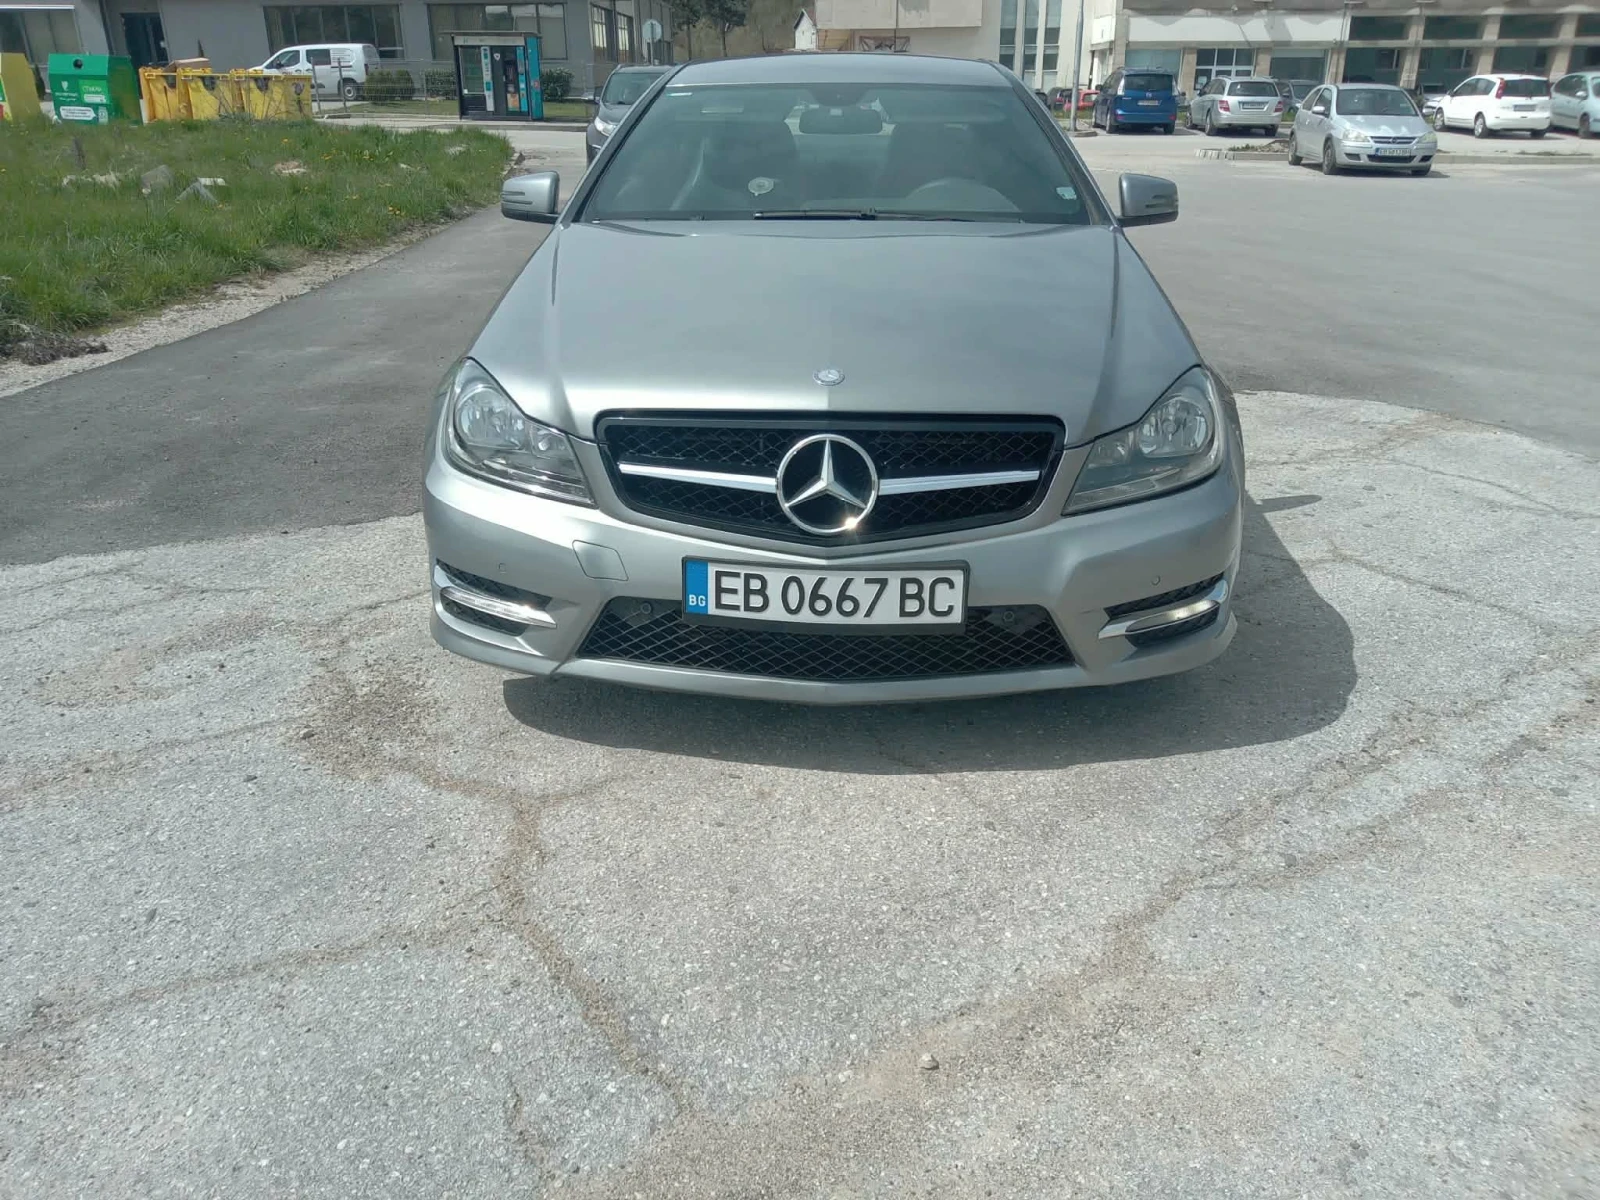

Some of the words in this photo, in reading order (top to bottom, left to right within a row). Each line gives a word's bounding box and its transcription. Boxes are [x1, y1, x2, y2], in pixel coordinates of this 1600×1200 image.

[688, 594, 706, 607] BG
[715, 570, 770, 612] EB
[781, 575, 889, 618] 0667
[899, 577, 955, 618] BC
